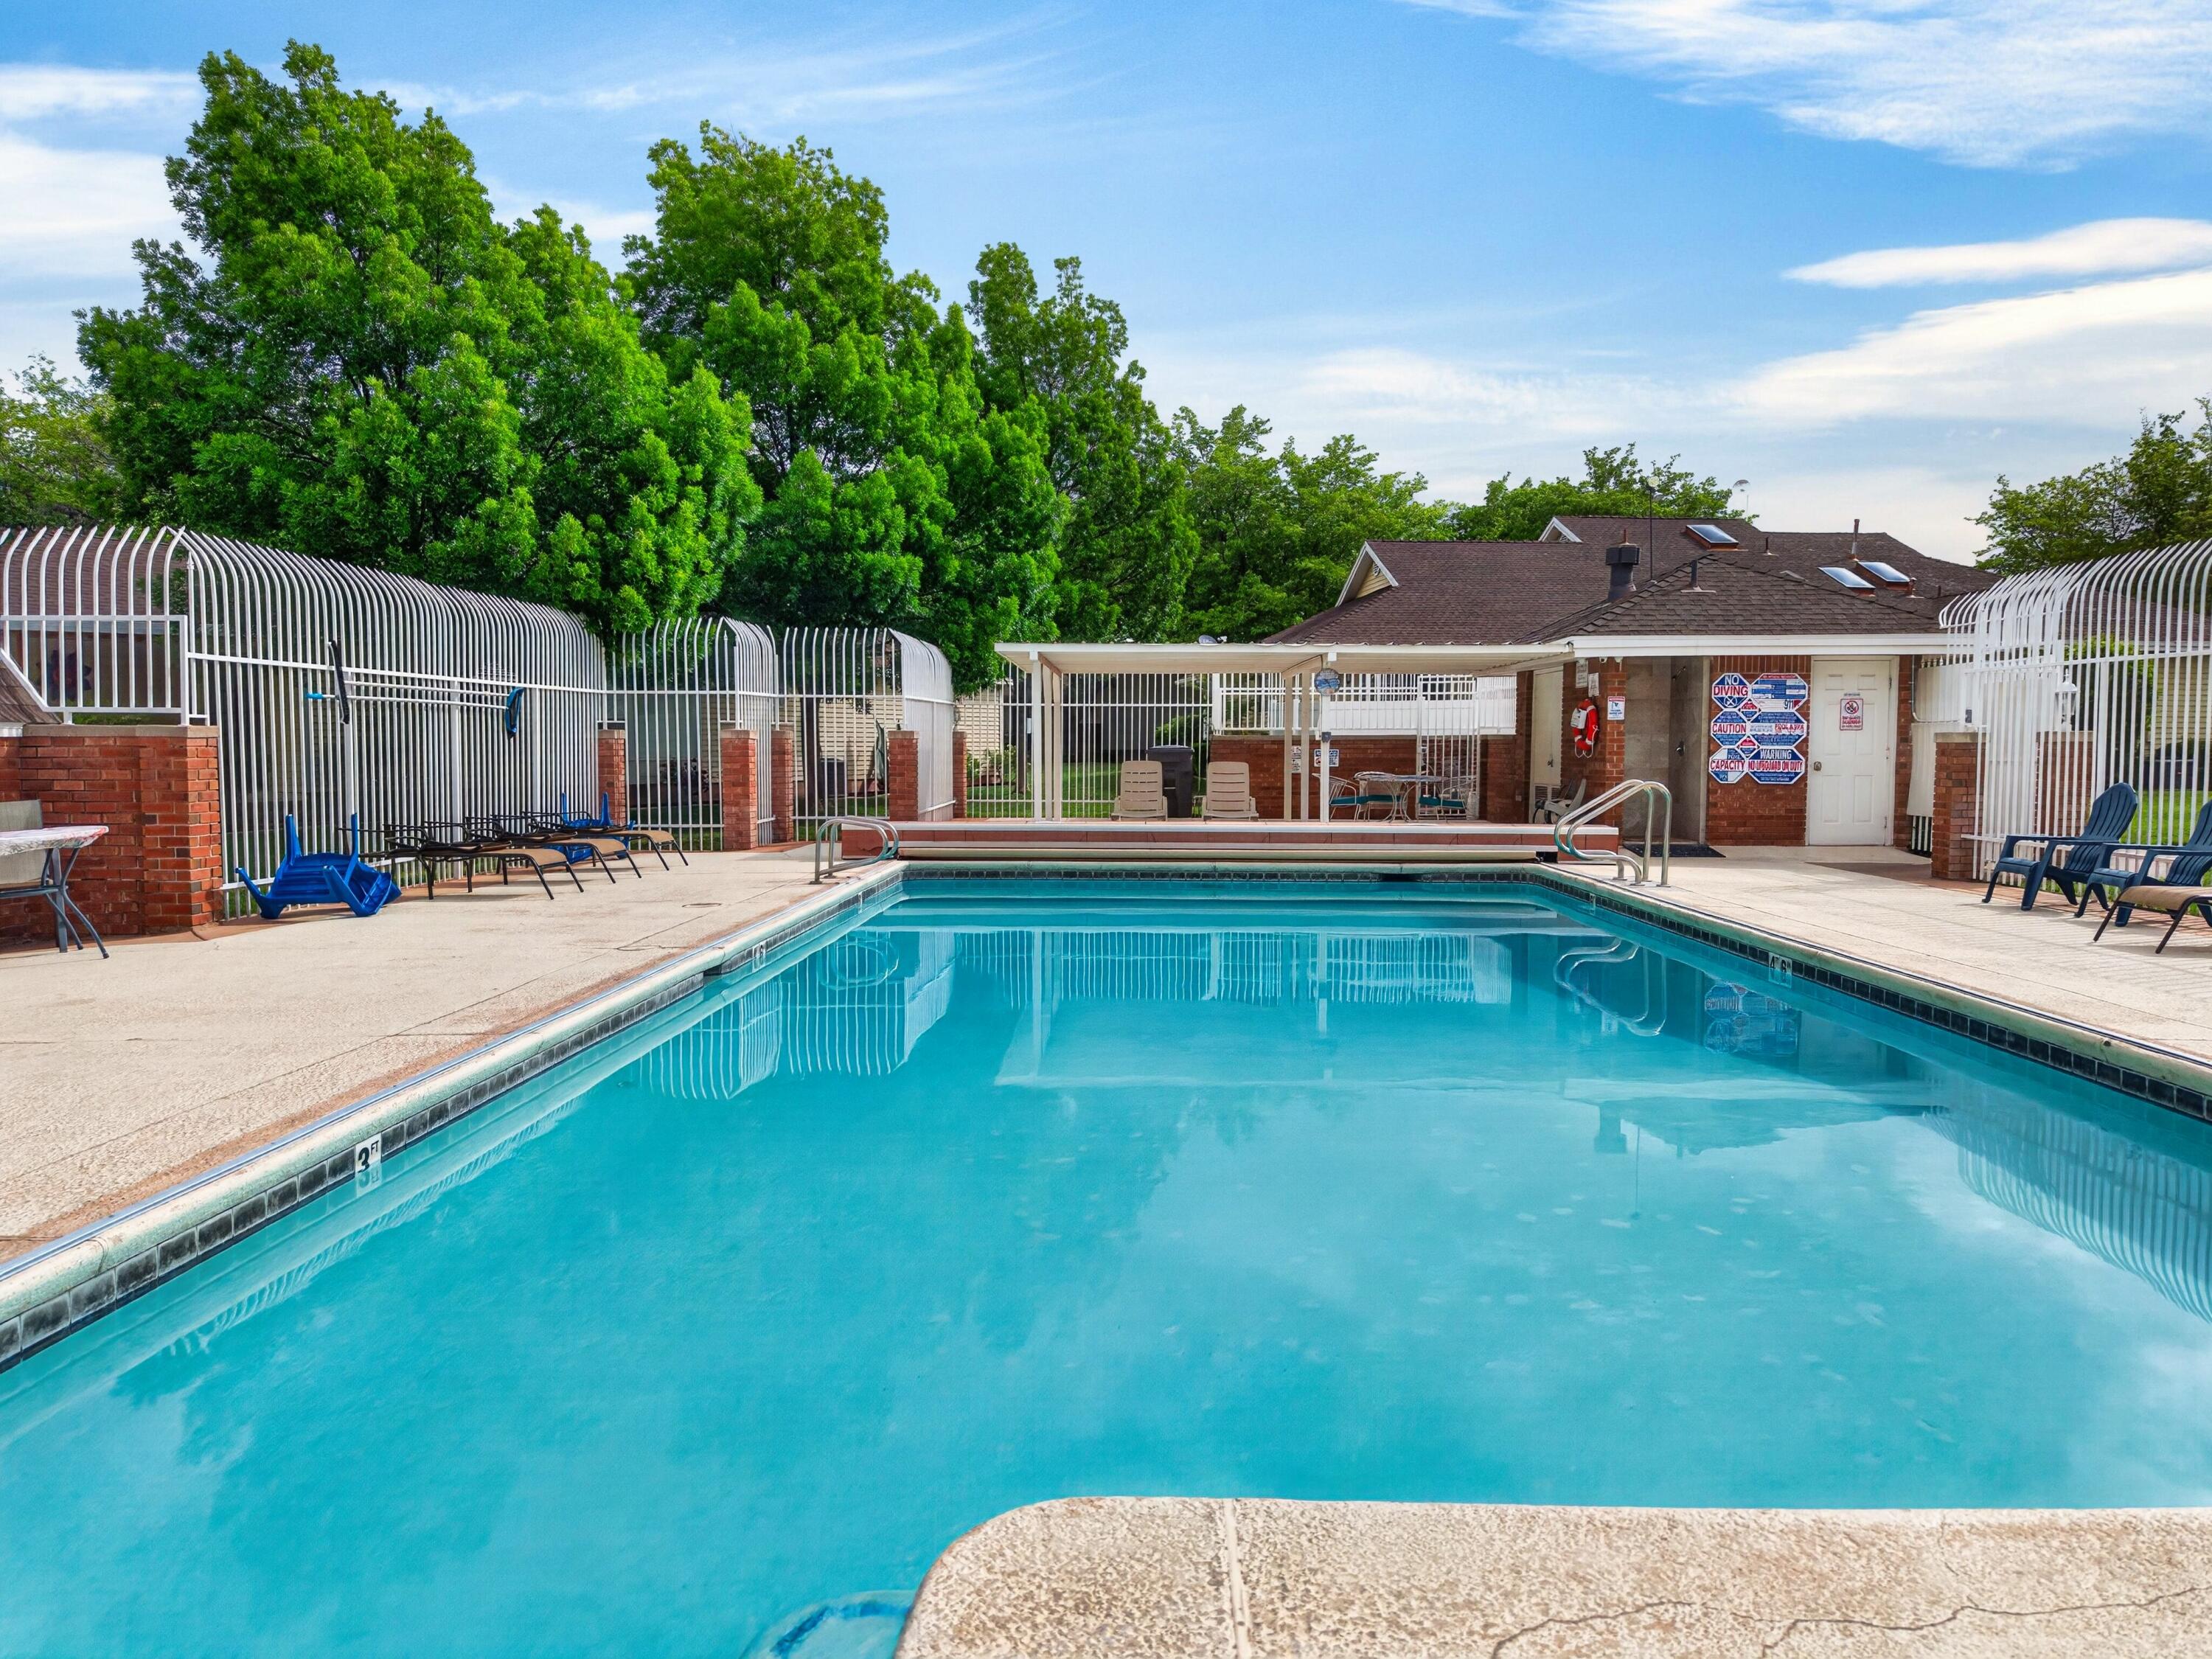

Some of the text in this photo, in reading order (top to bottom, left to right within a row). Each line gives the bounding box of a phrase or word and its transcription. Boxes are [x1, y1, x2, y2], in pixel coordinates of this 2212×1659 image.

[1725, 675, 1739, 685] NO
[1714, 686, 1748, 696] DIVING
[1712, 723, 1746, 733] CAUTION
[1760, 749, 1792, 759] WARNING
[1711, 760, 1745, 770] CAPACITY
[1770, 955, 1775, 969] 4
[371, 1140, 379, 1155] FT
